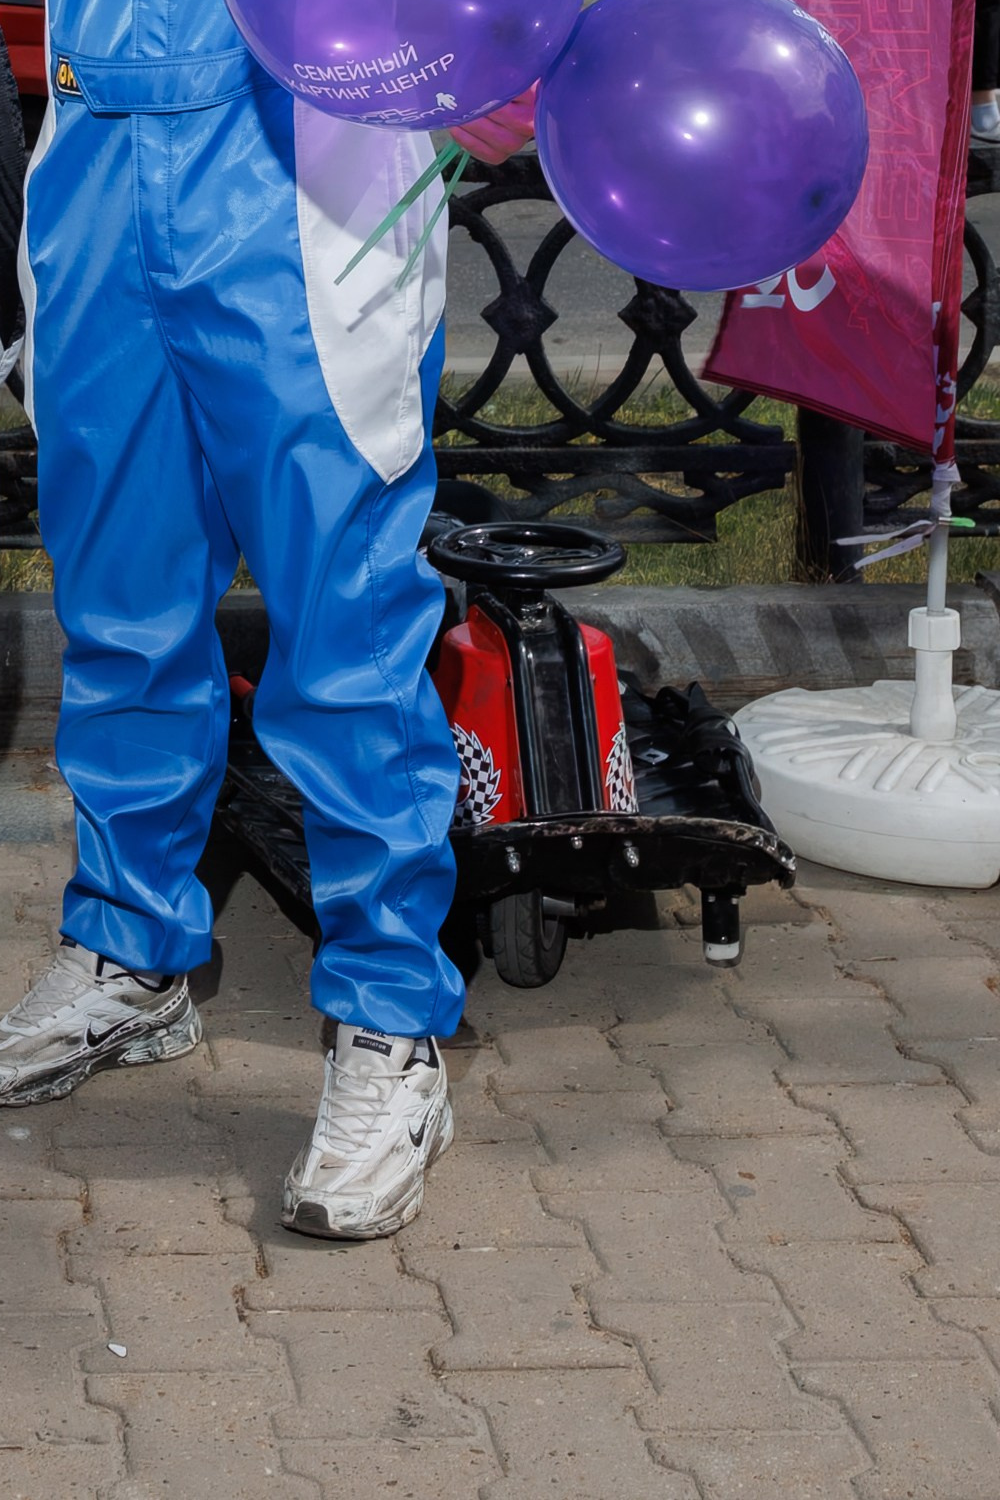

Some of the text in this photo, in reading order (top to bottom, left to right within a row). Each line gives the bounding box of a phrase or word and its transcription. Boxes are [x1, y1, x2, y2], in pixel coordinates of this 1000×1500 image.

[58, 63, 77, 88] OM
[284, 53, 455, 100] КАРТИНГ-ЦЕНТР
[293, 41, 418, 82] СЕМЕЙНЫЙ
